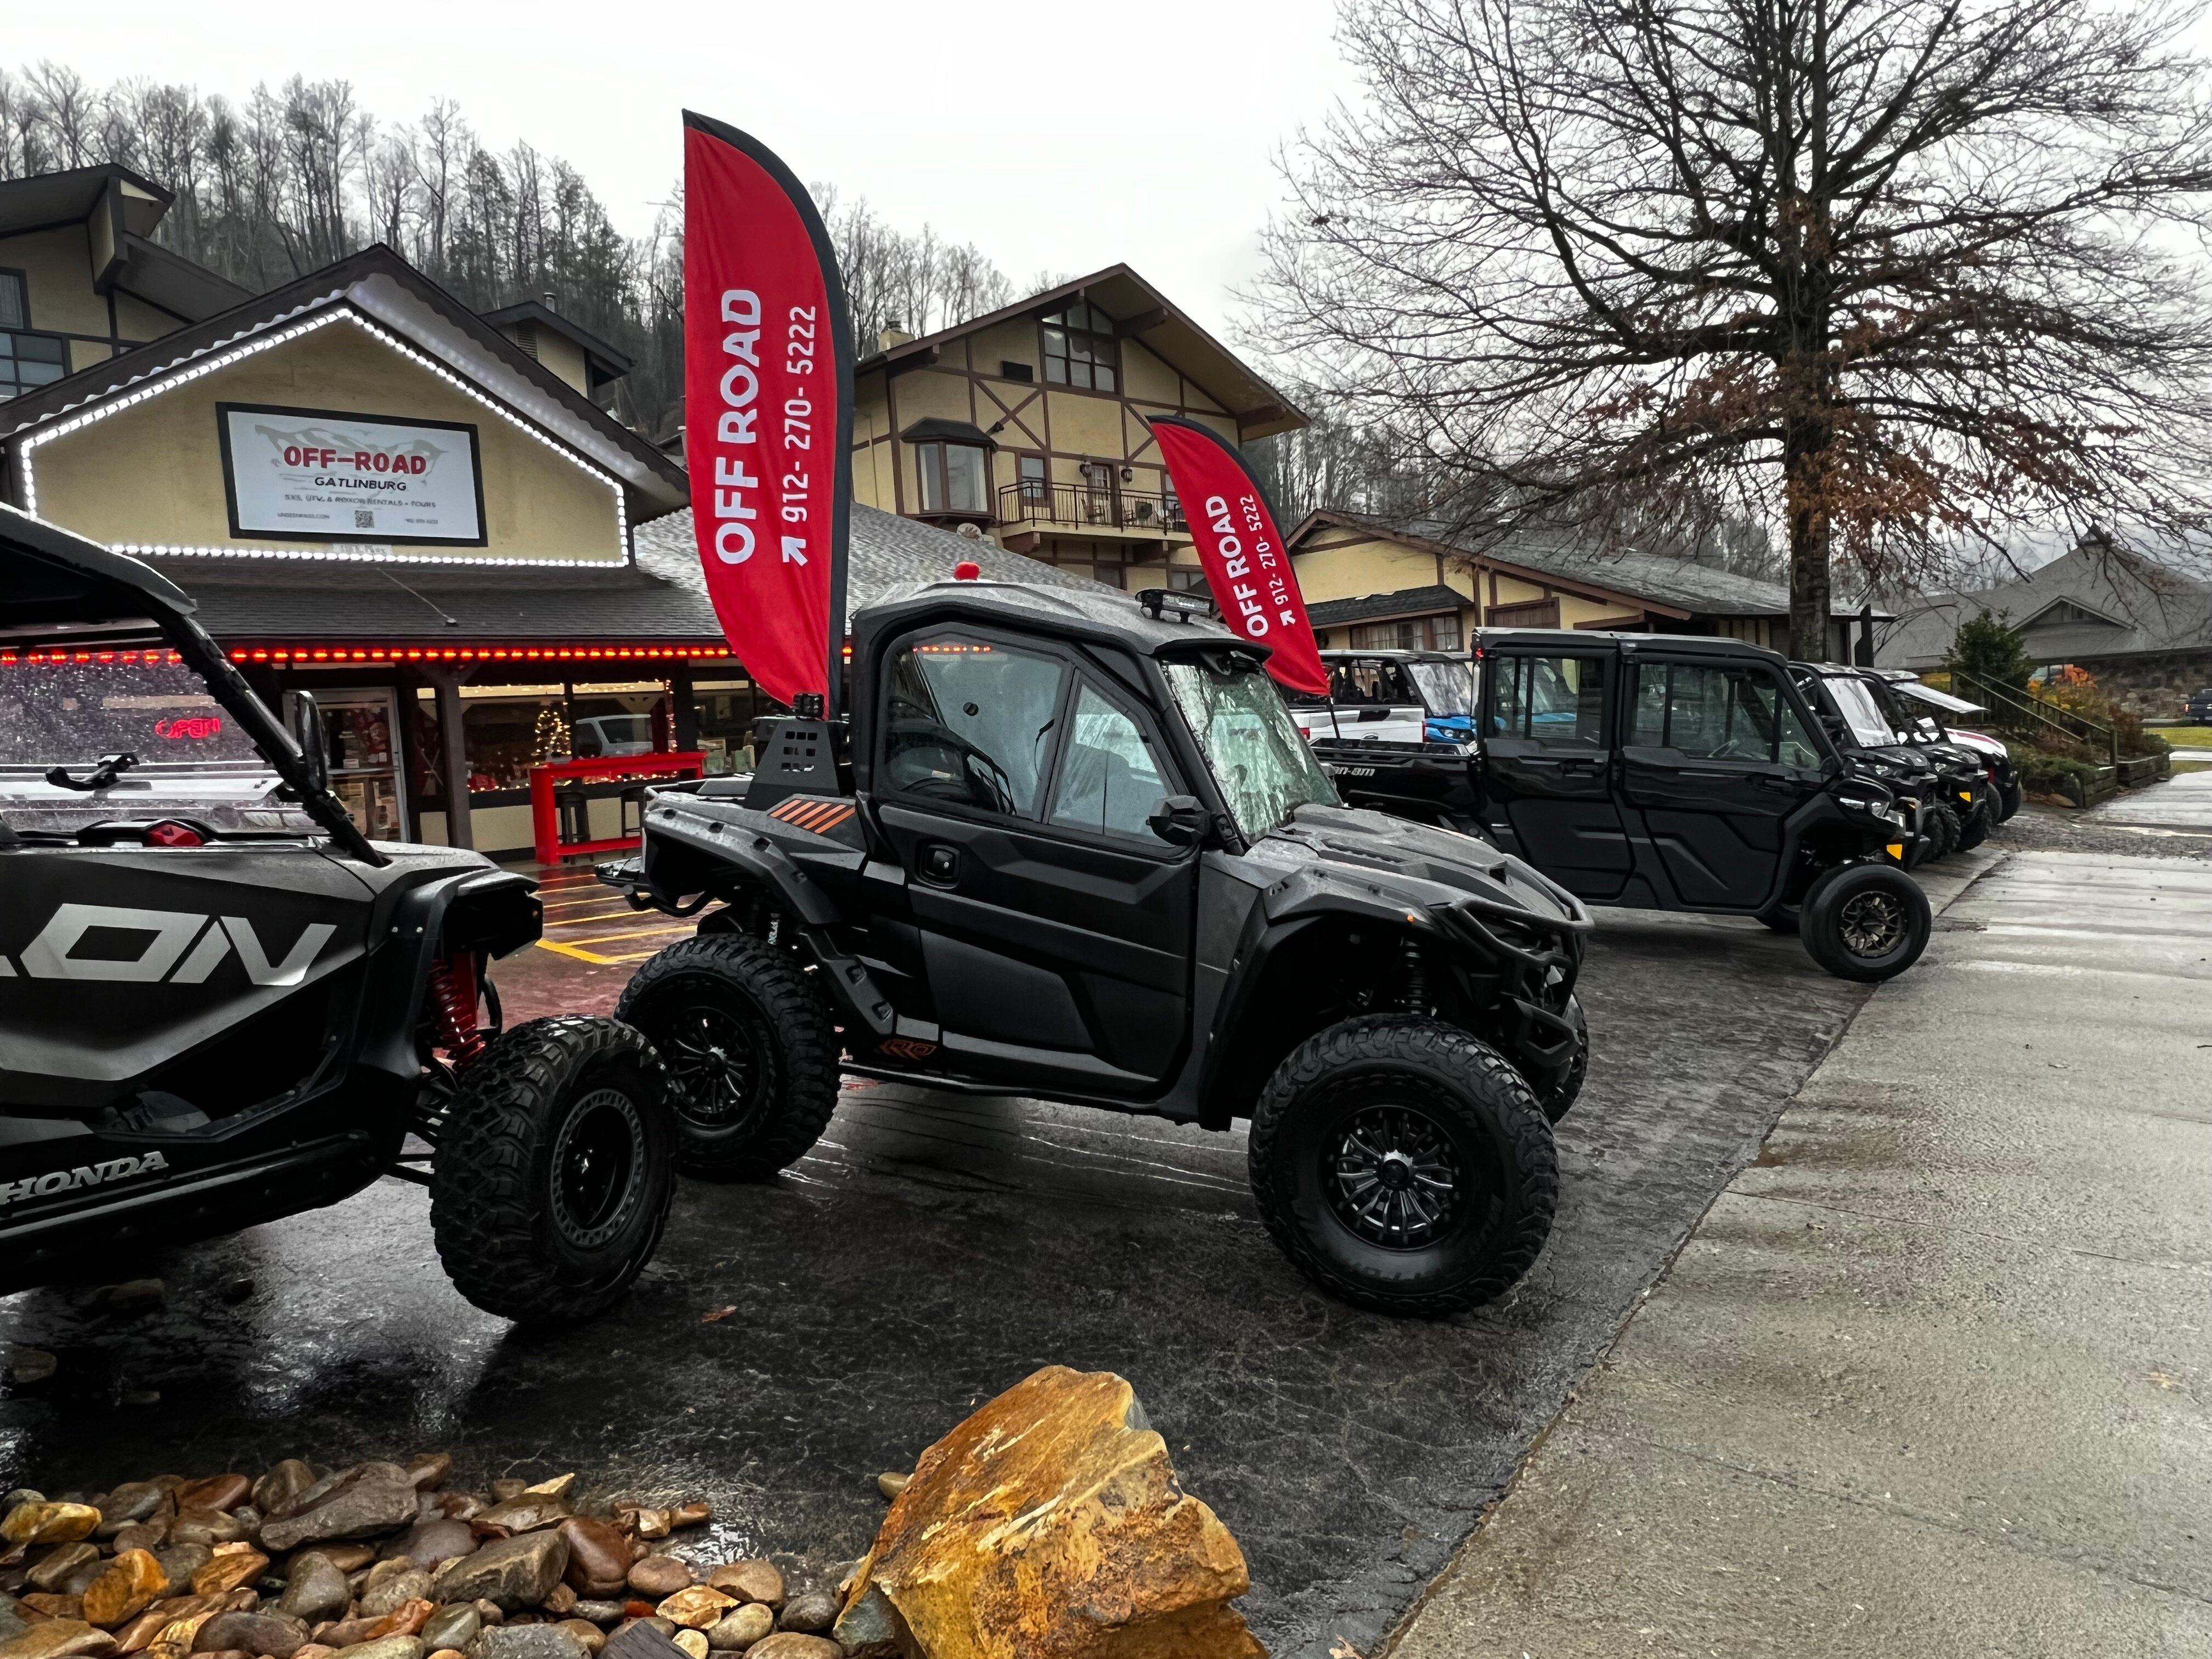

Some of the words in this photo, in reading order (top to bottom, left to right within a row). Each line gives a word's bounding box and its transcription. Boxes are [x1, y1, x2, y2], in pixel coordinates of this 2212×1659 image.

[718, 289, 761, 444] ROAD
[786, 306, 816, 375] 5222
[284, 445, 427, 475] OFF-ROAD
[314, 476, 407, 491] GATLINBURG
[715, 456, 759, 565] OFF
[1205, 495, 1250, 579] ROAD
[1239, 494, 1263, 532] 5222
[1233, 583, 1269, 637] OFF
[0, 903, 337, 986] ON
[0, 1150, 170, 1206] HONDA
